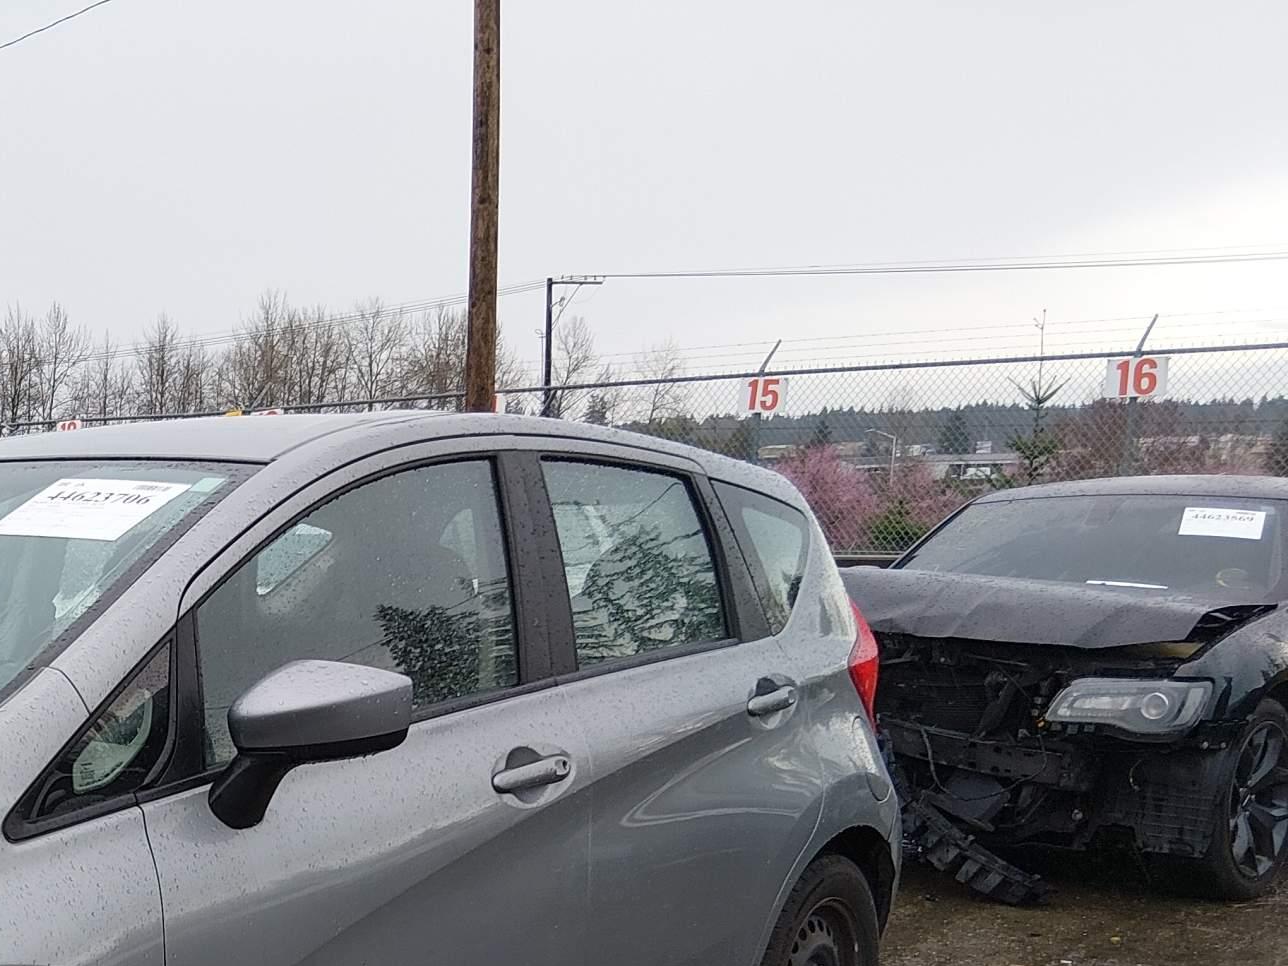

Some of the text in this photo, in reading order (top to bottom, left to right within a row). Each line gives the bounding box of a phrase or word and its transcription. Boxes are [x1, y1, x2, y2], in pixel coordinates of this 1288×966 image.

[1116, 357, 1158, 396] 16
[747, 378, 781, 412] 15
[47, 490, 153, 505] 44623706
